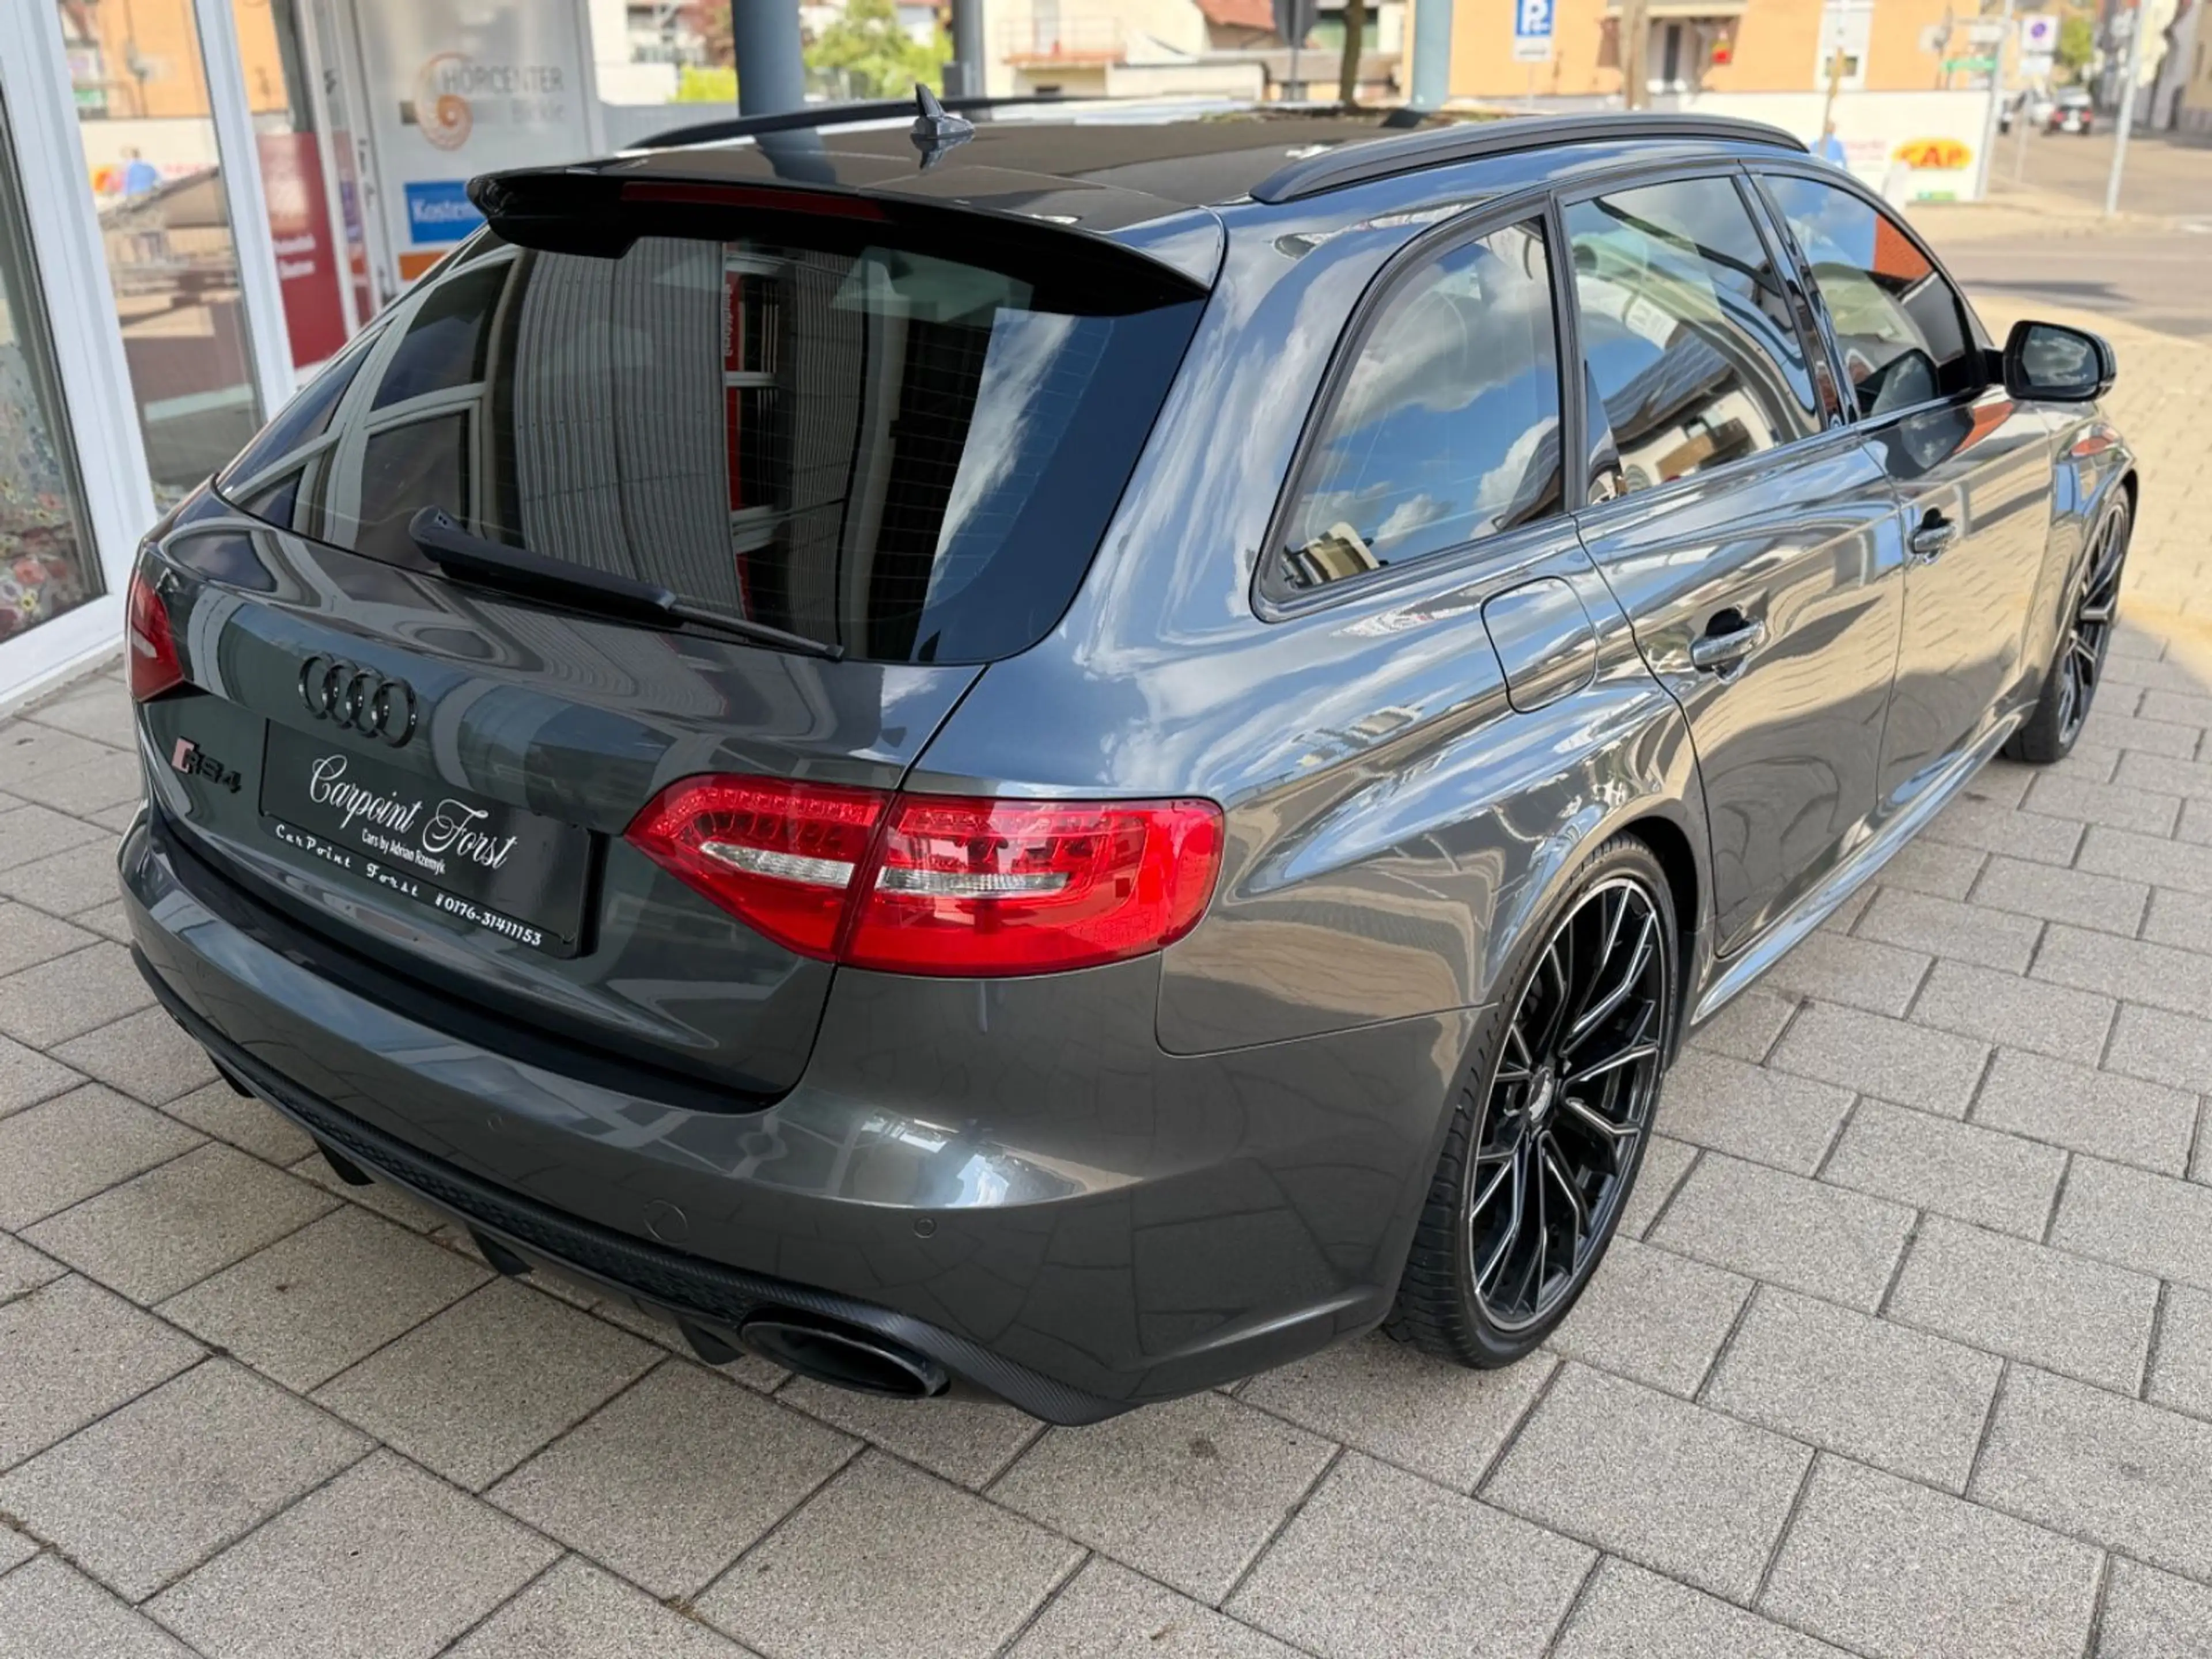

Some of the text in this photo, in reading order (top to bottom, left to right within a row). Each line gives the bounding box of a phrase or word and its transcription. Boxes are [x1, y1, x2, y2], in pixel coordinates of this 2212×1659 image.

[310, 754, 517, 869] Carpoint Forst
[362, 828, 378, 847] Cars
[379, 835, 389, 854] by
[390, 839, 414, 862] Adrian
